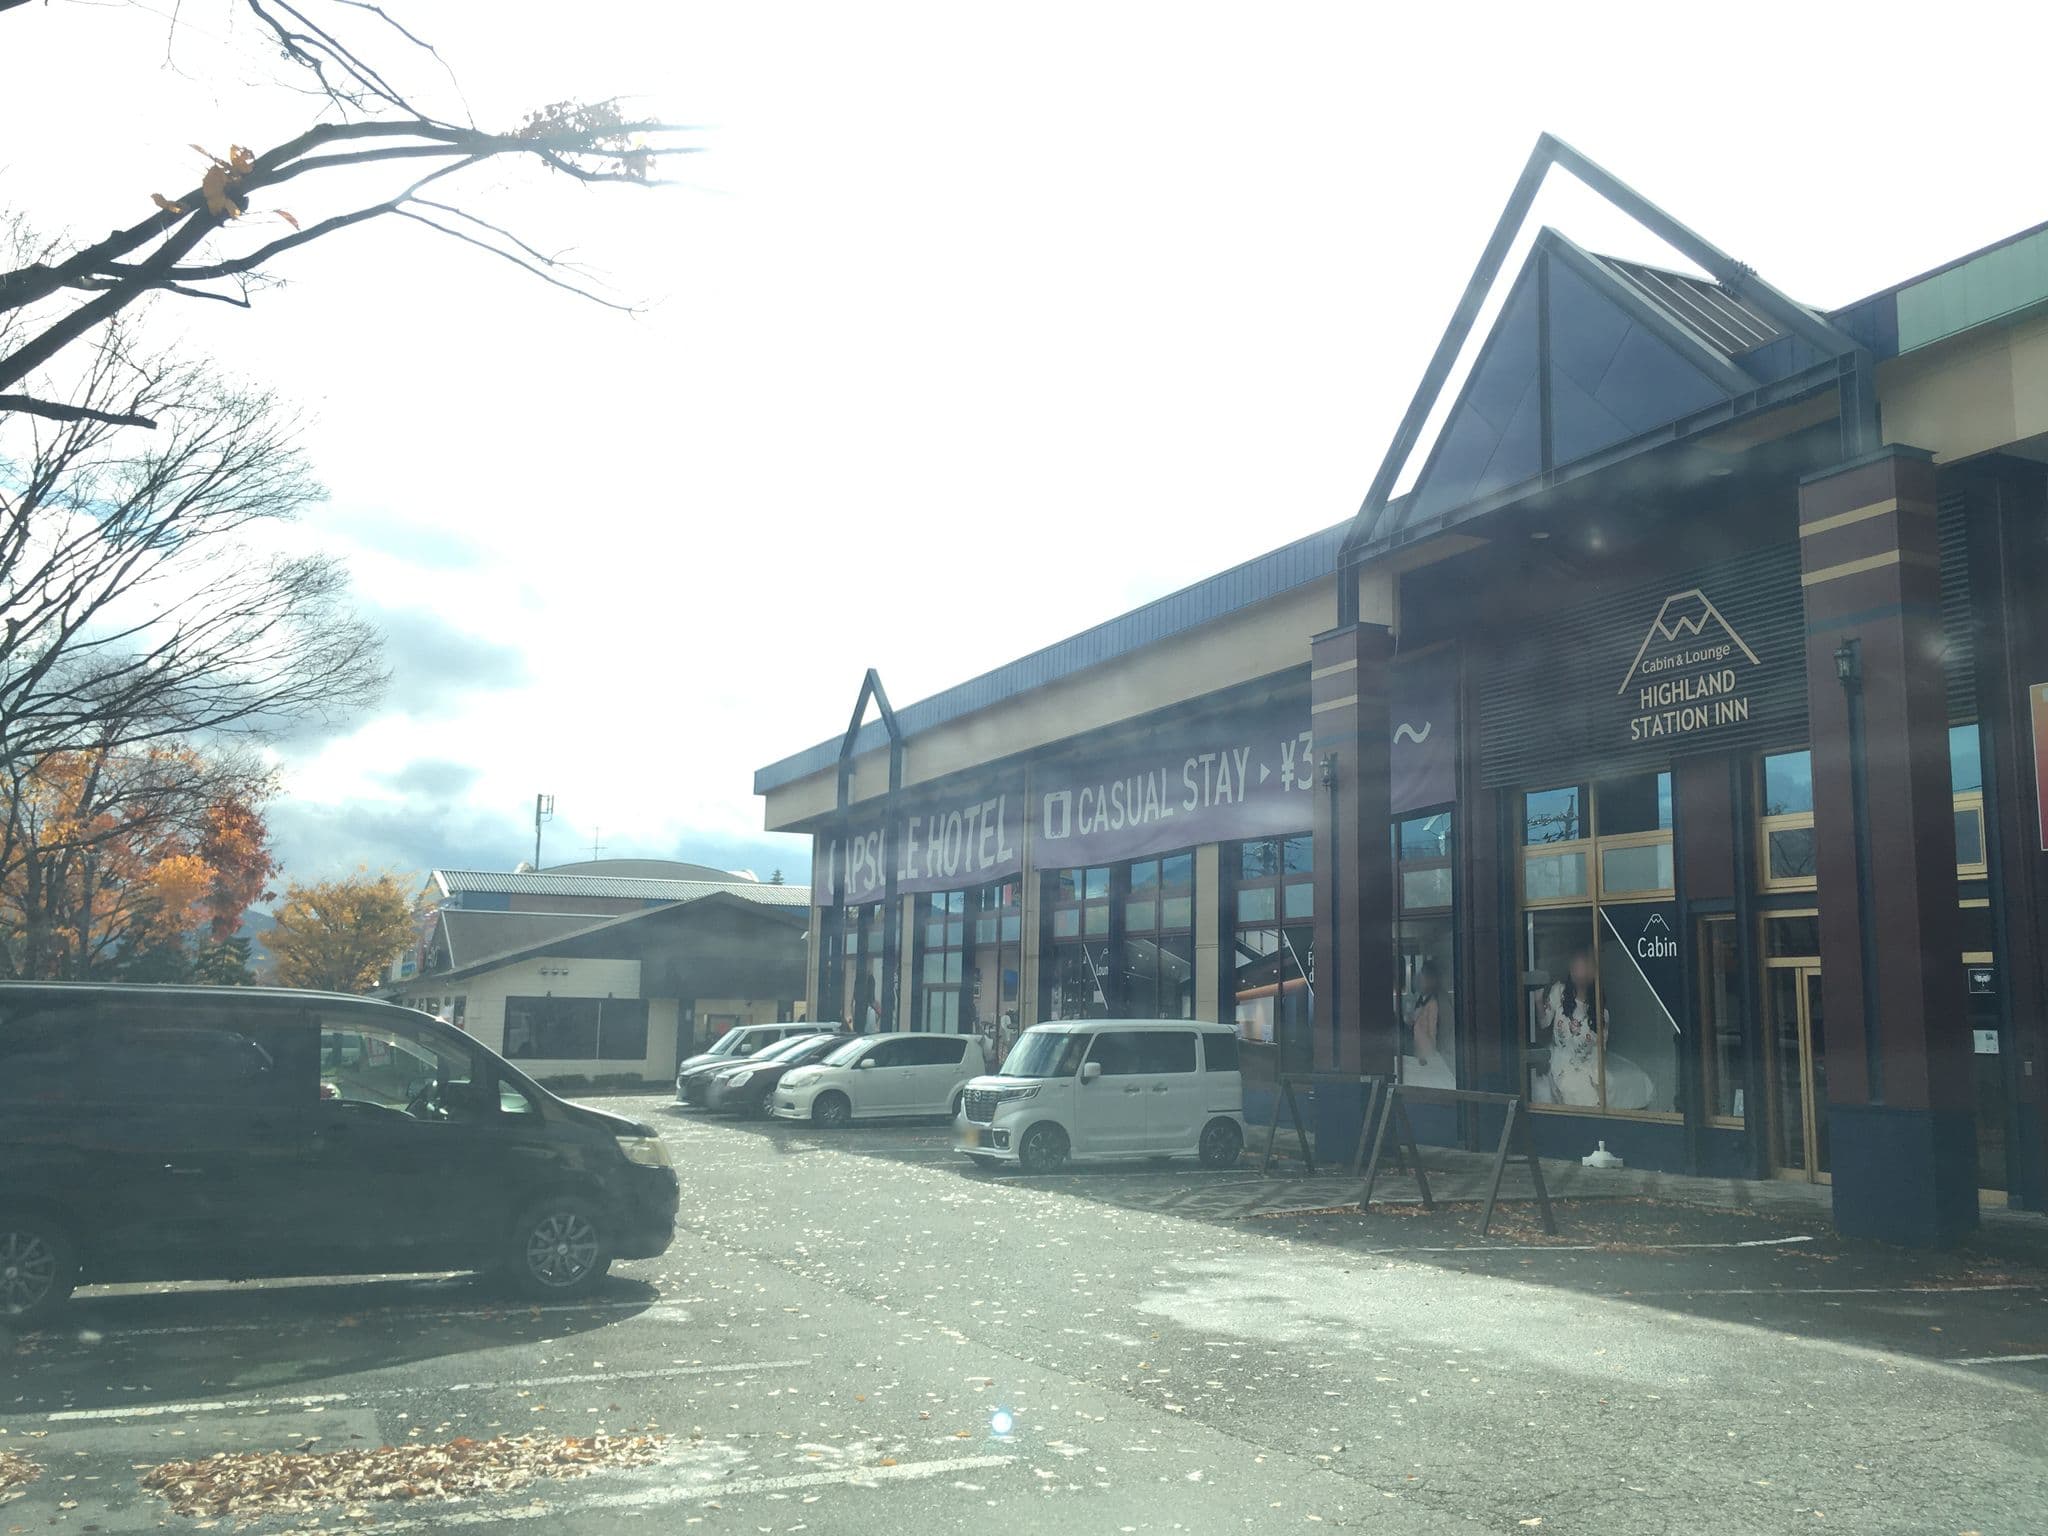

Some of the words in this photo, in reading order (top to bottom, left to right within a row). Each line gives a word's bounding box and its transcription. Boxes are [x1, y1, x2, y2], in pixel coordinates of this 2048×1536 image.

[1641, 654, 1675, 674] Cabin
[1685, 644, 1731, 665] Lounge
[1640, 669, 1736, 710] HIGHLAND
[1630, 704, 1708, 741] STATION
[1715, 697, 1749, 726] INN
[1078, 767, 1174, 836] CASUAL
[1182, 746, 1251, 812] STAY
[827, 816, 921, 896] CAPSUE
[926, 794, 1013, 878] HOTEL
[1637, 935, 1677, 958] Cabin
